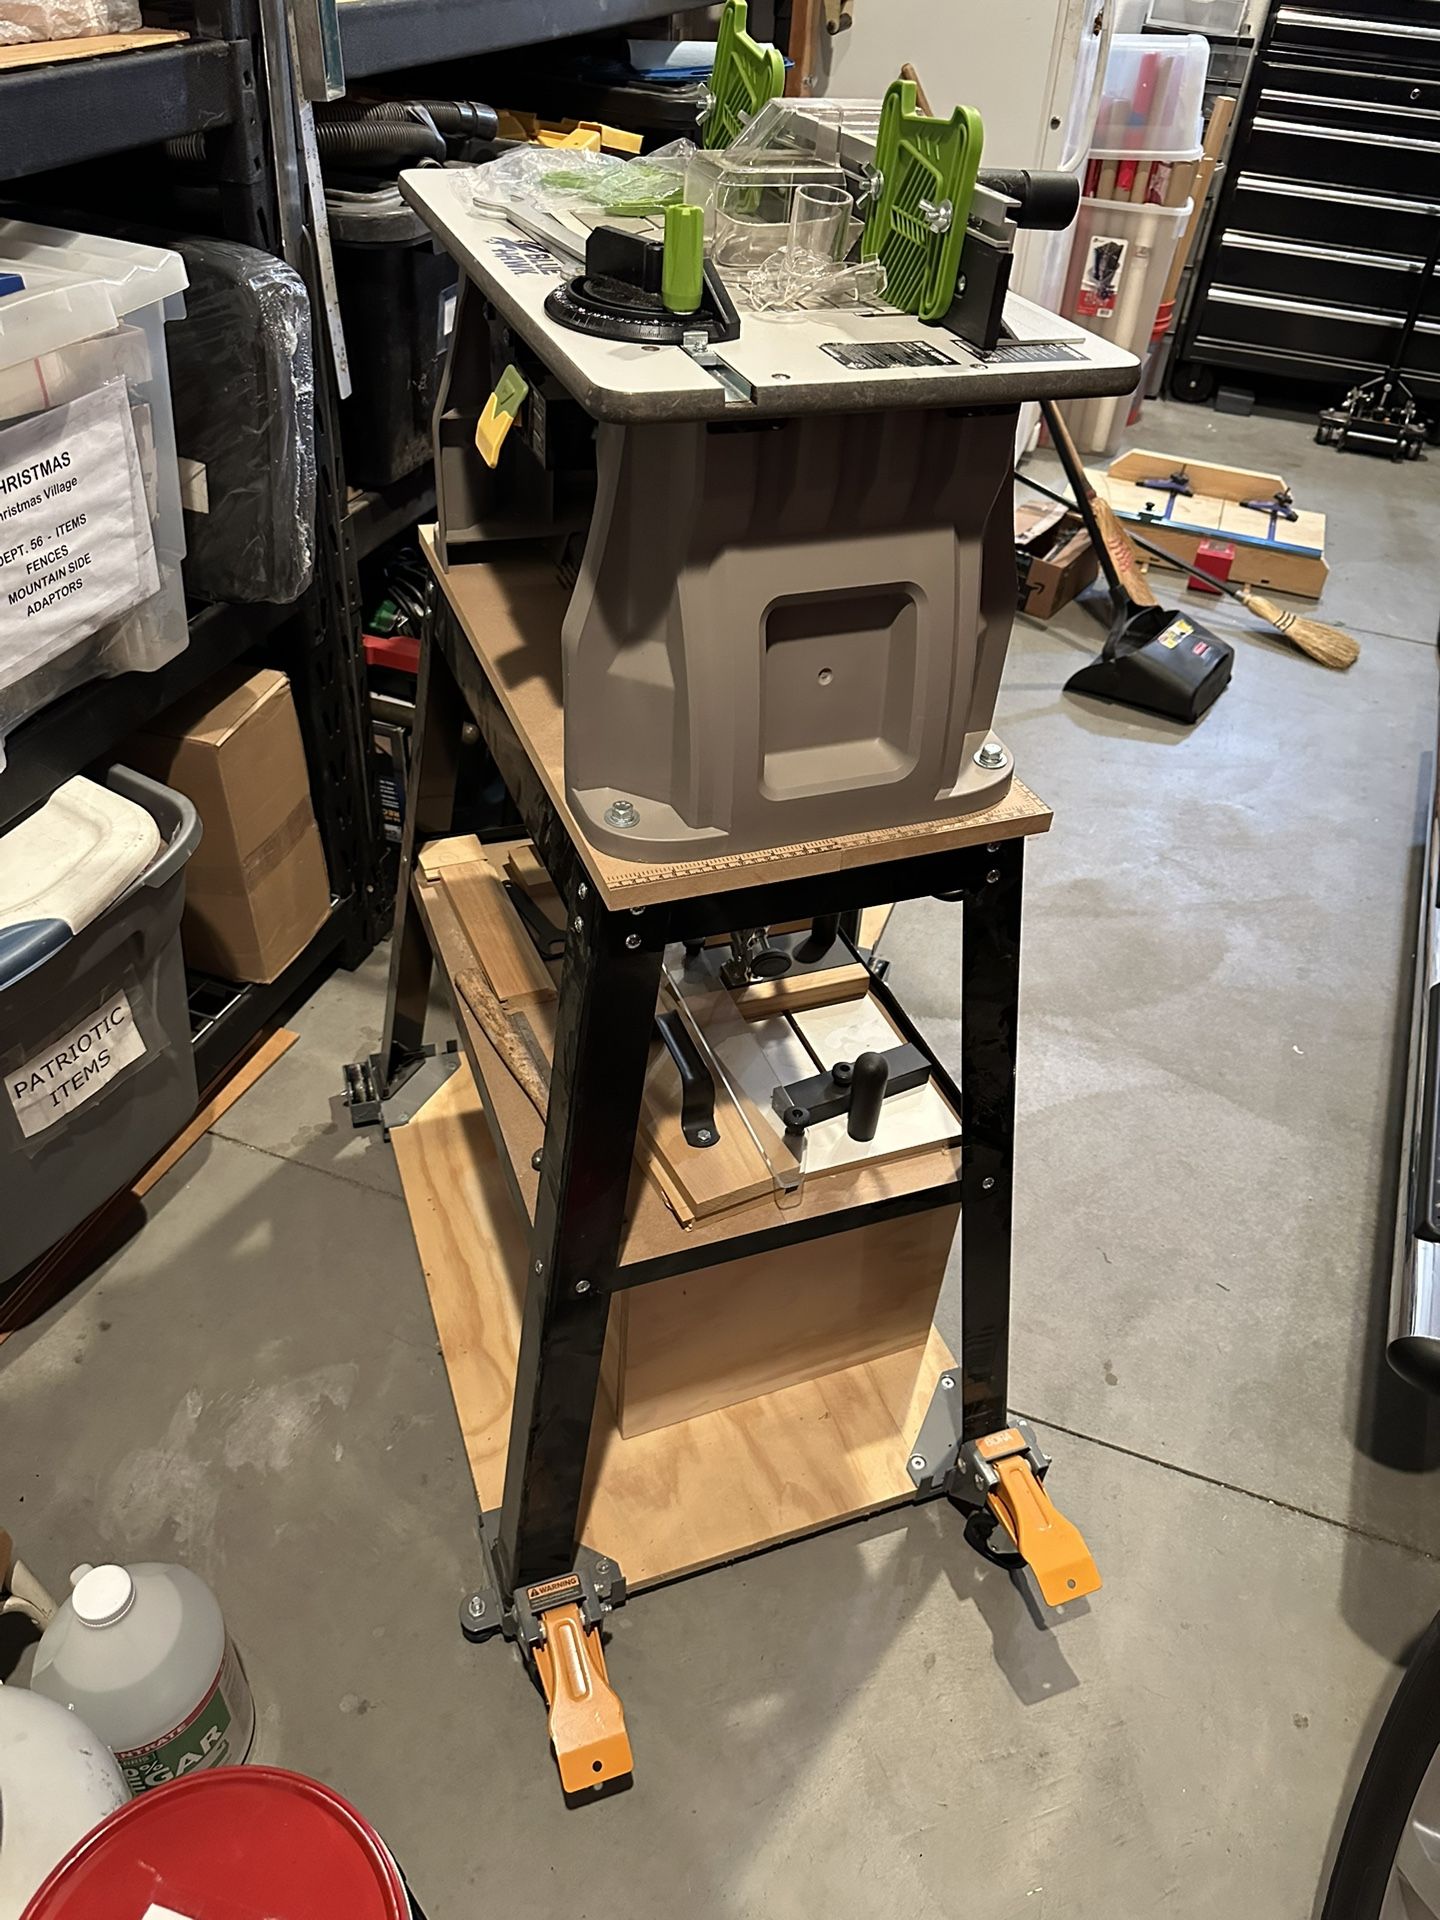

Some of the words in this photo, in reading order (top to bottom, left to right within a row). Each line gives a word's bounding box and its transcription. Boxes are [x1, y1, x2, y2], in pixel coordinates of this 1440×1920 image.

[43, 476, 78, 500] Village
[30, 535, 43, 551] 56
[55, 513, 87, 537] ITEMS
[8, 566, 67, 605] MOUNTAIN
[68, 552, 92, 574] SIDE
[26, 545, 69, 574] FENCES
[27, 578, 83, 617] ADAPTORS
[13, 1006, 125, 1098] PATRIOTIC
[49, 1048, 111, 1107] ITEMS
[539, 1577, 577, 1594] WARNING
